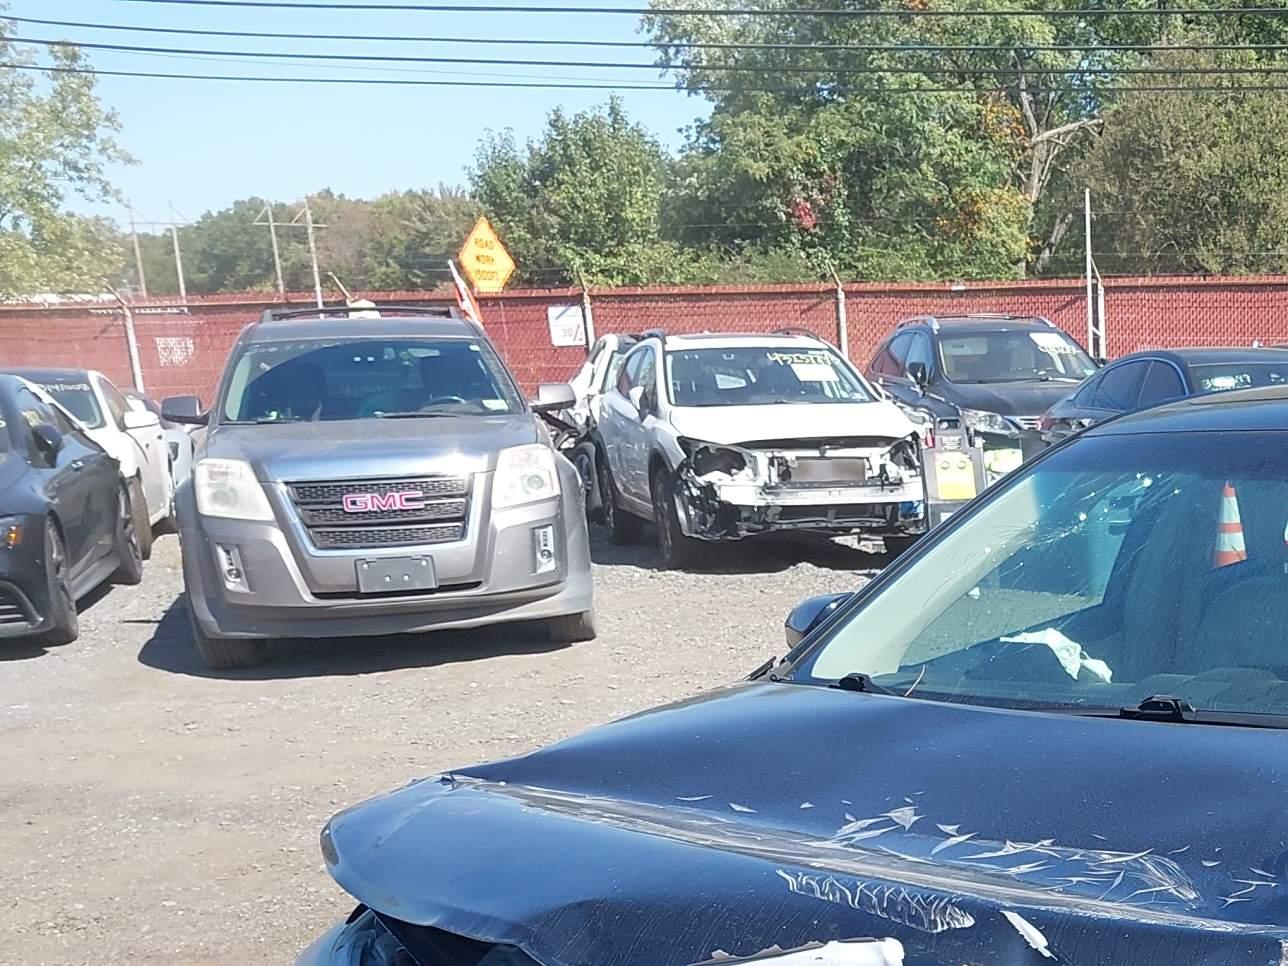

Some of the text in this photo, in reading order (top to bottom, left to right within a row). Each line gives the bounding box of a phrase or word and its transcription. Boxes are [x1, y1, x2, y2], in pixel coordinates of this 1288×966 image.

[474, 238, 495, 250] ROAD
[475, 255, 496, 265] WORK
[342, 490, 425, 513] GMC
